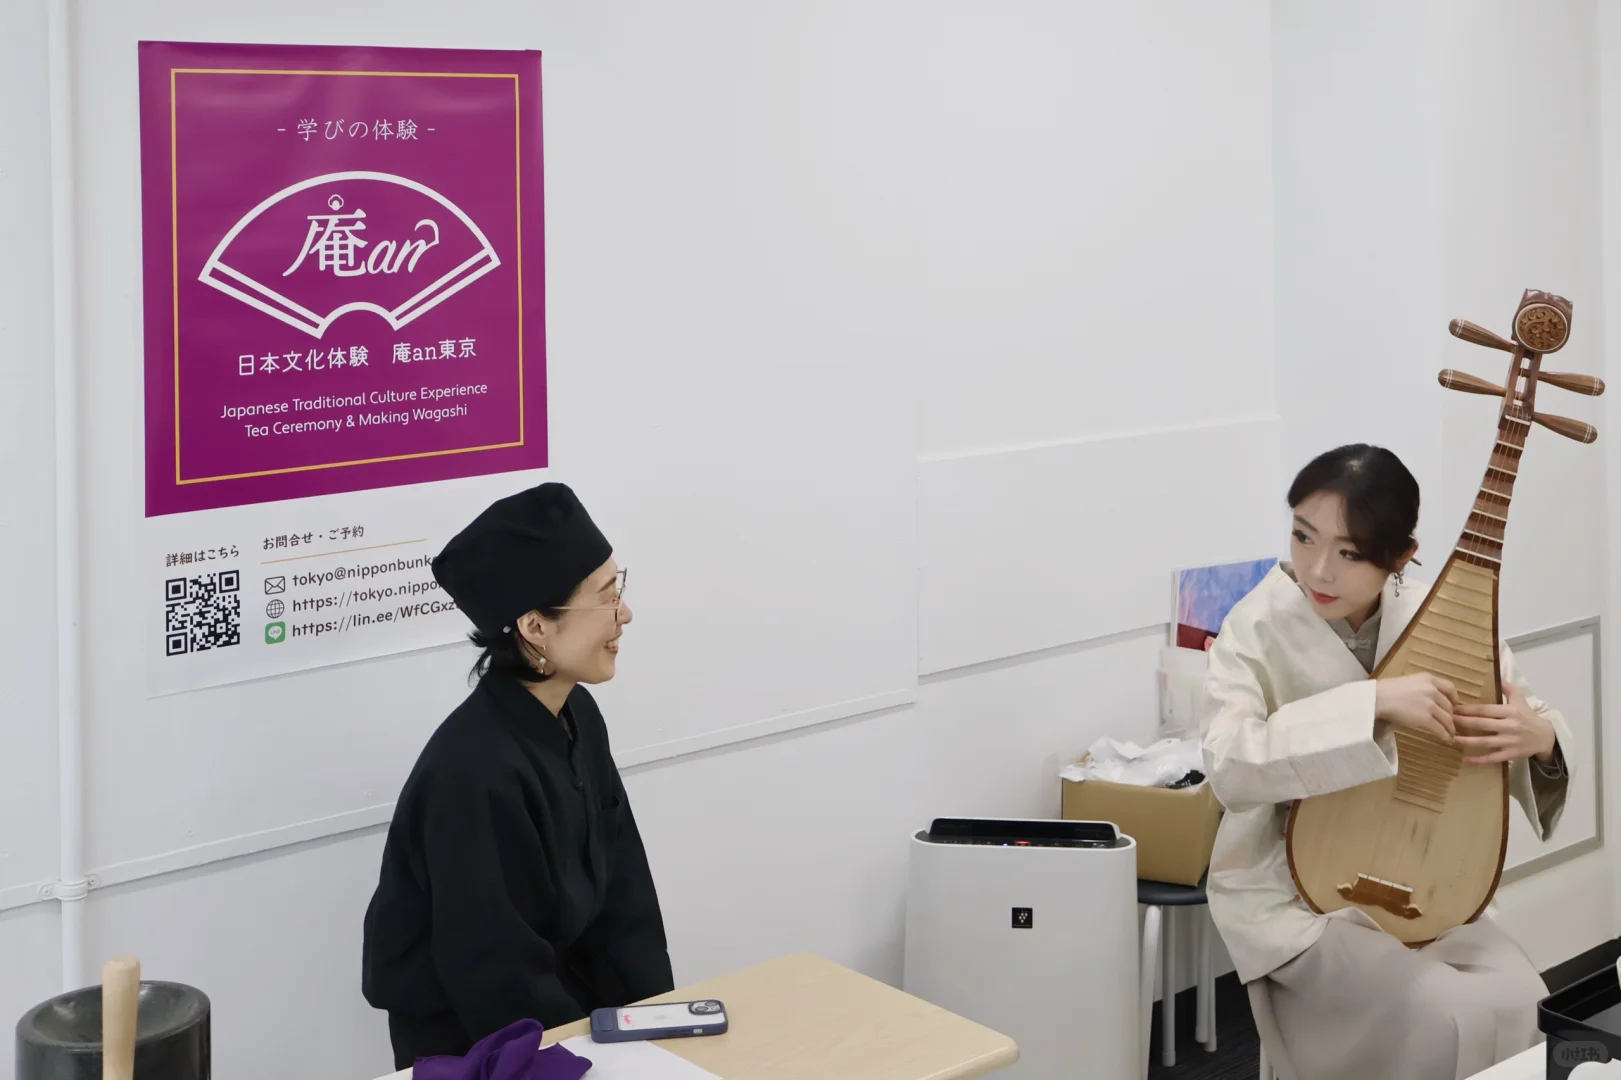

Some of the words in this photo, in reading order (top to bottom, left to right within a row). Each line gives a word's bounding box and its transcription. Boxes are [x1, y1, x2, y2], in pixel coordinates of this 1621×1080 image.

[297, 117, 419, 142] 学びの体験
[238, 345, 370, 376] 日本文化体験
[392, 336, 477, 364] 庵an東京
[220, 401, 289, 419] Japanese
[292, 391, 367, 412] Traditional
[369, 389, 417, 405] Culture
[420, 382, 488, 401] Experience
[244, 424, 269, 438] Tea
[272, 418, 343, 435] Ceremony
[345, 414, 355, 428] &
[358, 409, 409, 427] Making
[412, 403, 468, 422] Wagashi
[262, 525, 364, 551] お問合せ・ご予約
[165, 544, 240, 568] 詳細はこちら
[291, 553, 433, 587] tokyo@nipponbunk
[292, 579, 441, 613] https://tokyo.nippo
[292, 600, 458, 638] https://lin.ee/WfCGxz
